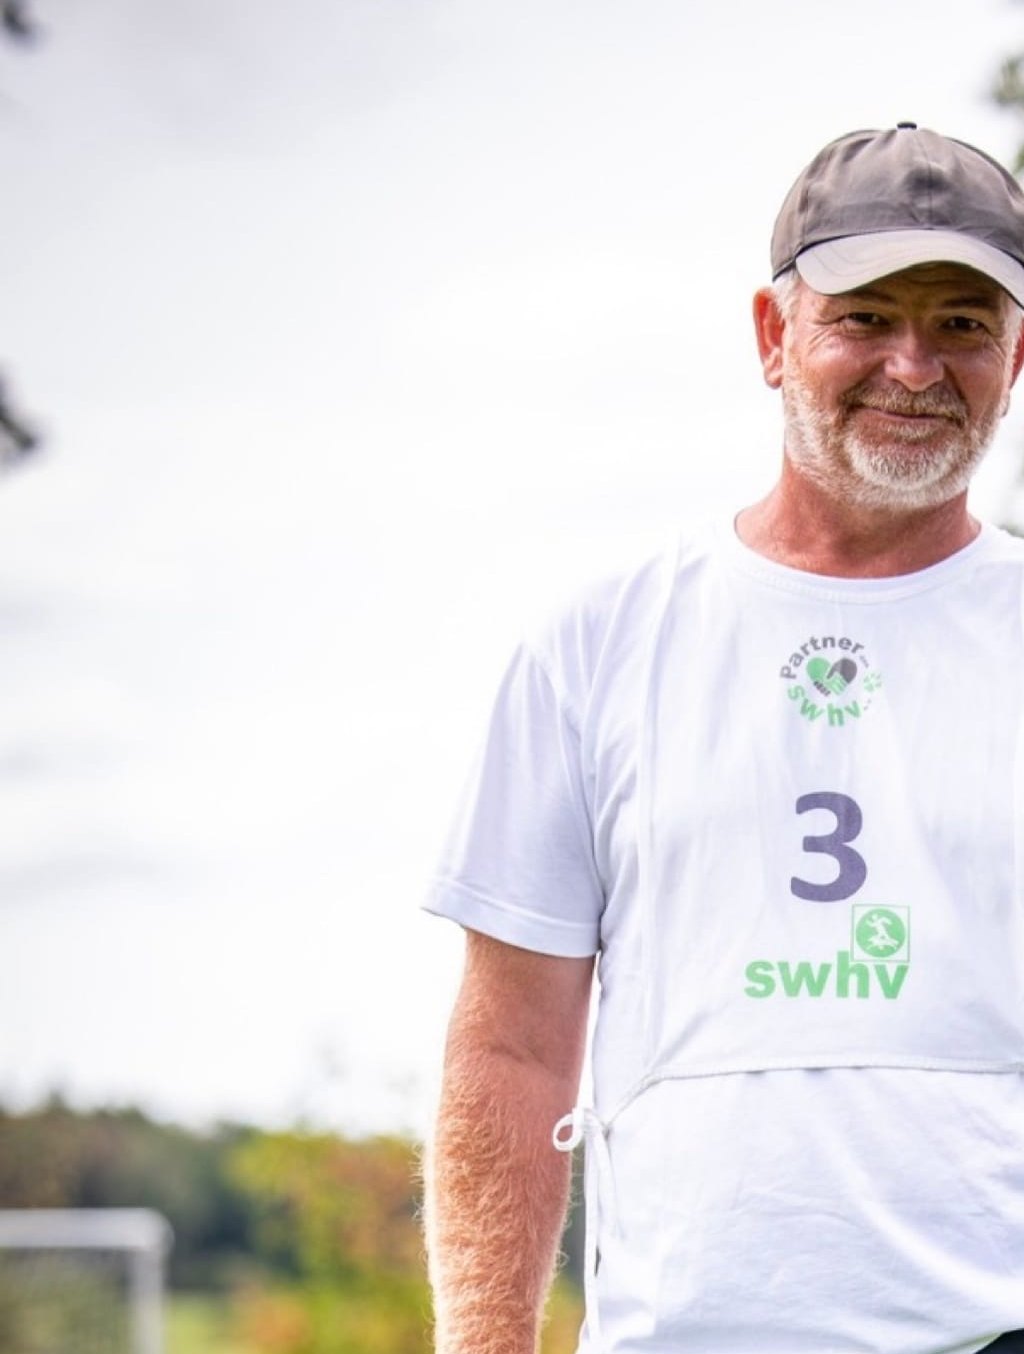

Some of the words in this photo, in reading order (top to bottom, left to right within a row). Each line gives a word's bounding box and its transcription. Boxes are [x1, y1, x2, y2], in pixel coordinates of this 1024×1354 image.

[787, 684, 862, 727] swhv
[790, 791, 868, 903] 3
[744, 950, 910, 1000] swhv
